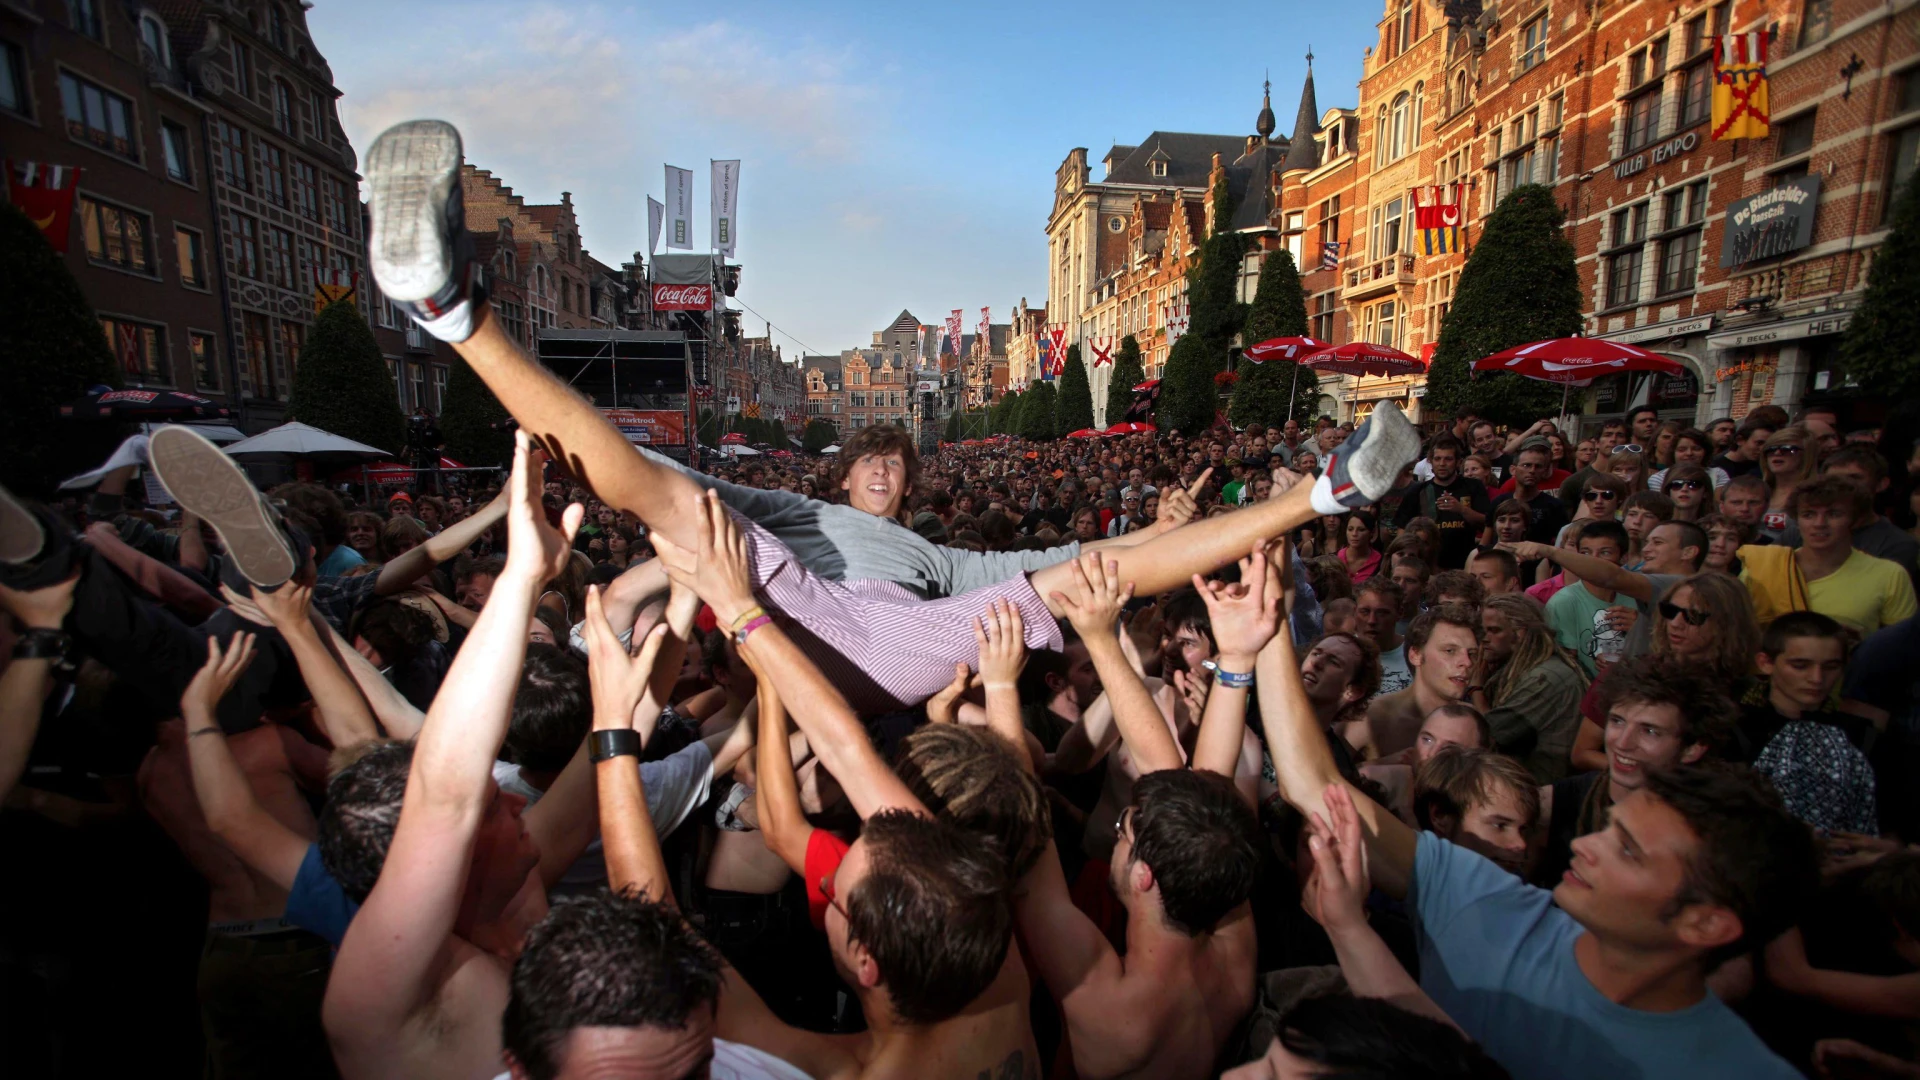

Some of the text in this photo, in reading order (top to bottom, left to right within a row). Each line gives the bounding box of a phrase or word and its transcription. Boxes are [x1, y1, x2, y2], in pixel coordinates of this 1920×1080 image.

[1613, 132, 1696, 180] VILLA TEMPO
[1733, 185, 1809, 226] De Bierkelder
[654, 286, 709, 305] Coca-Cola
[1746, 331, 1777, 343] BECK'S
[1363, 355, 1388, 363] STELLA
